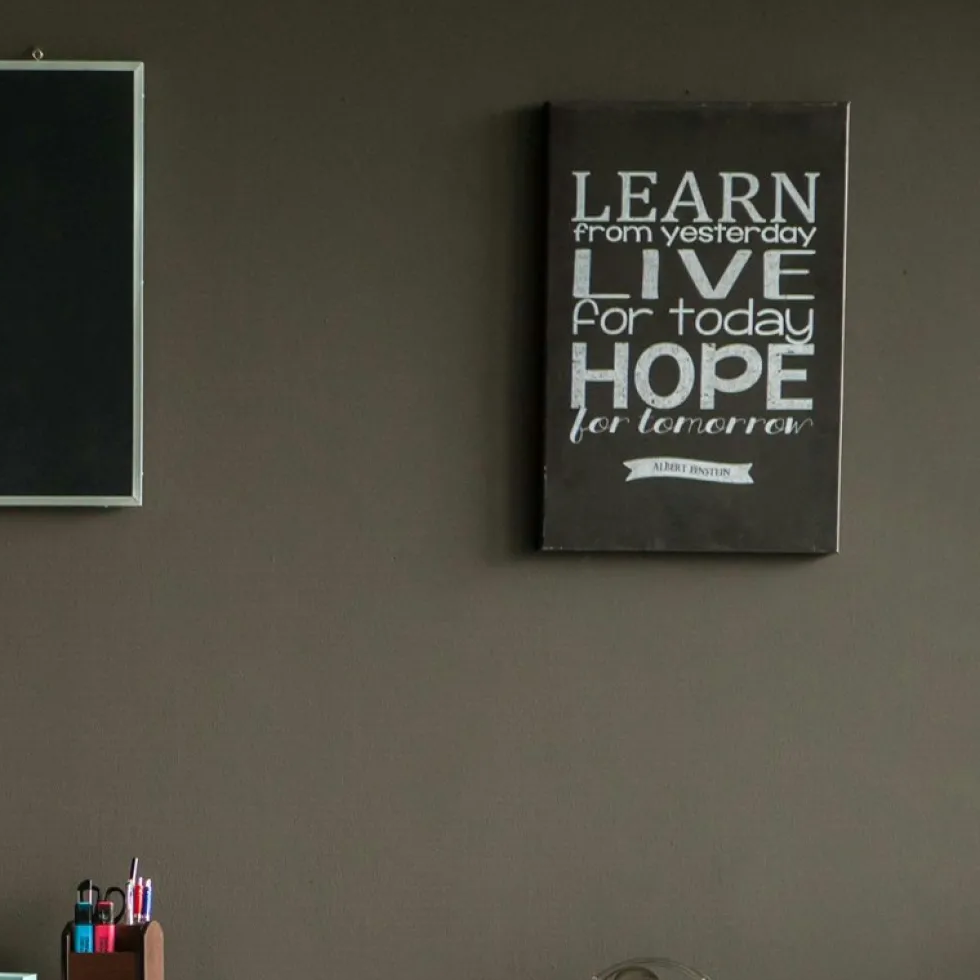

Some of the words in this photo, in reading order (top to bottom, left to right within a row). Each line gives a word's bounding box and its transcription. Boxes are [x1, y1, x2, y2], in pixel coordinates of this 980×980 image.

[571, 171, 820, 223] LEARN
[573, 222, 652, 242] from
[660, 223, 817, 248] yesterday
[573, 248, 816, 300] LIVE
[572, 298, 654, 336] for
[669, 298, 814, 345] today
[570, 342, 815, 410] HOPE
[570, 407, 630, 444] for
[638, 408, 813, 434] tomorrow
[653, 461, 686, 474] ALBERT
